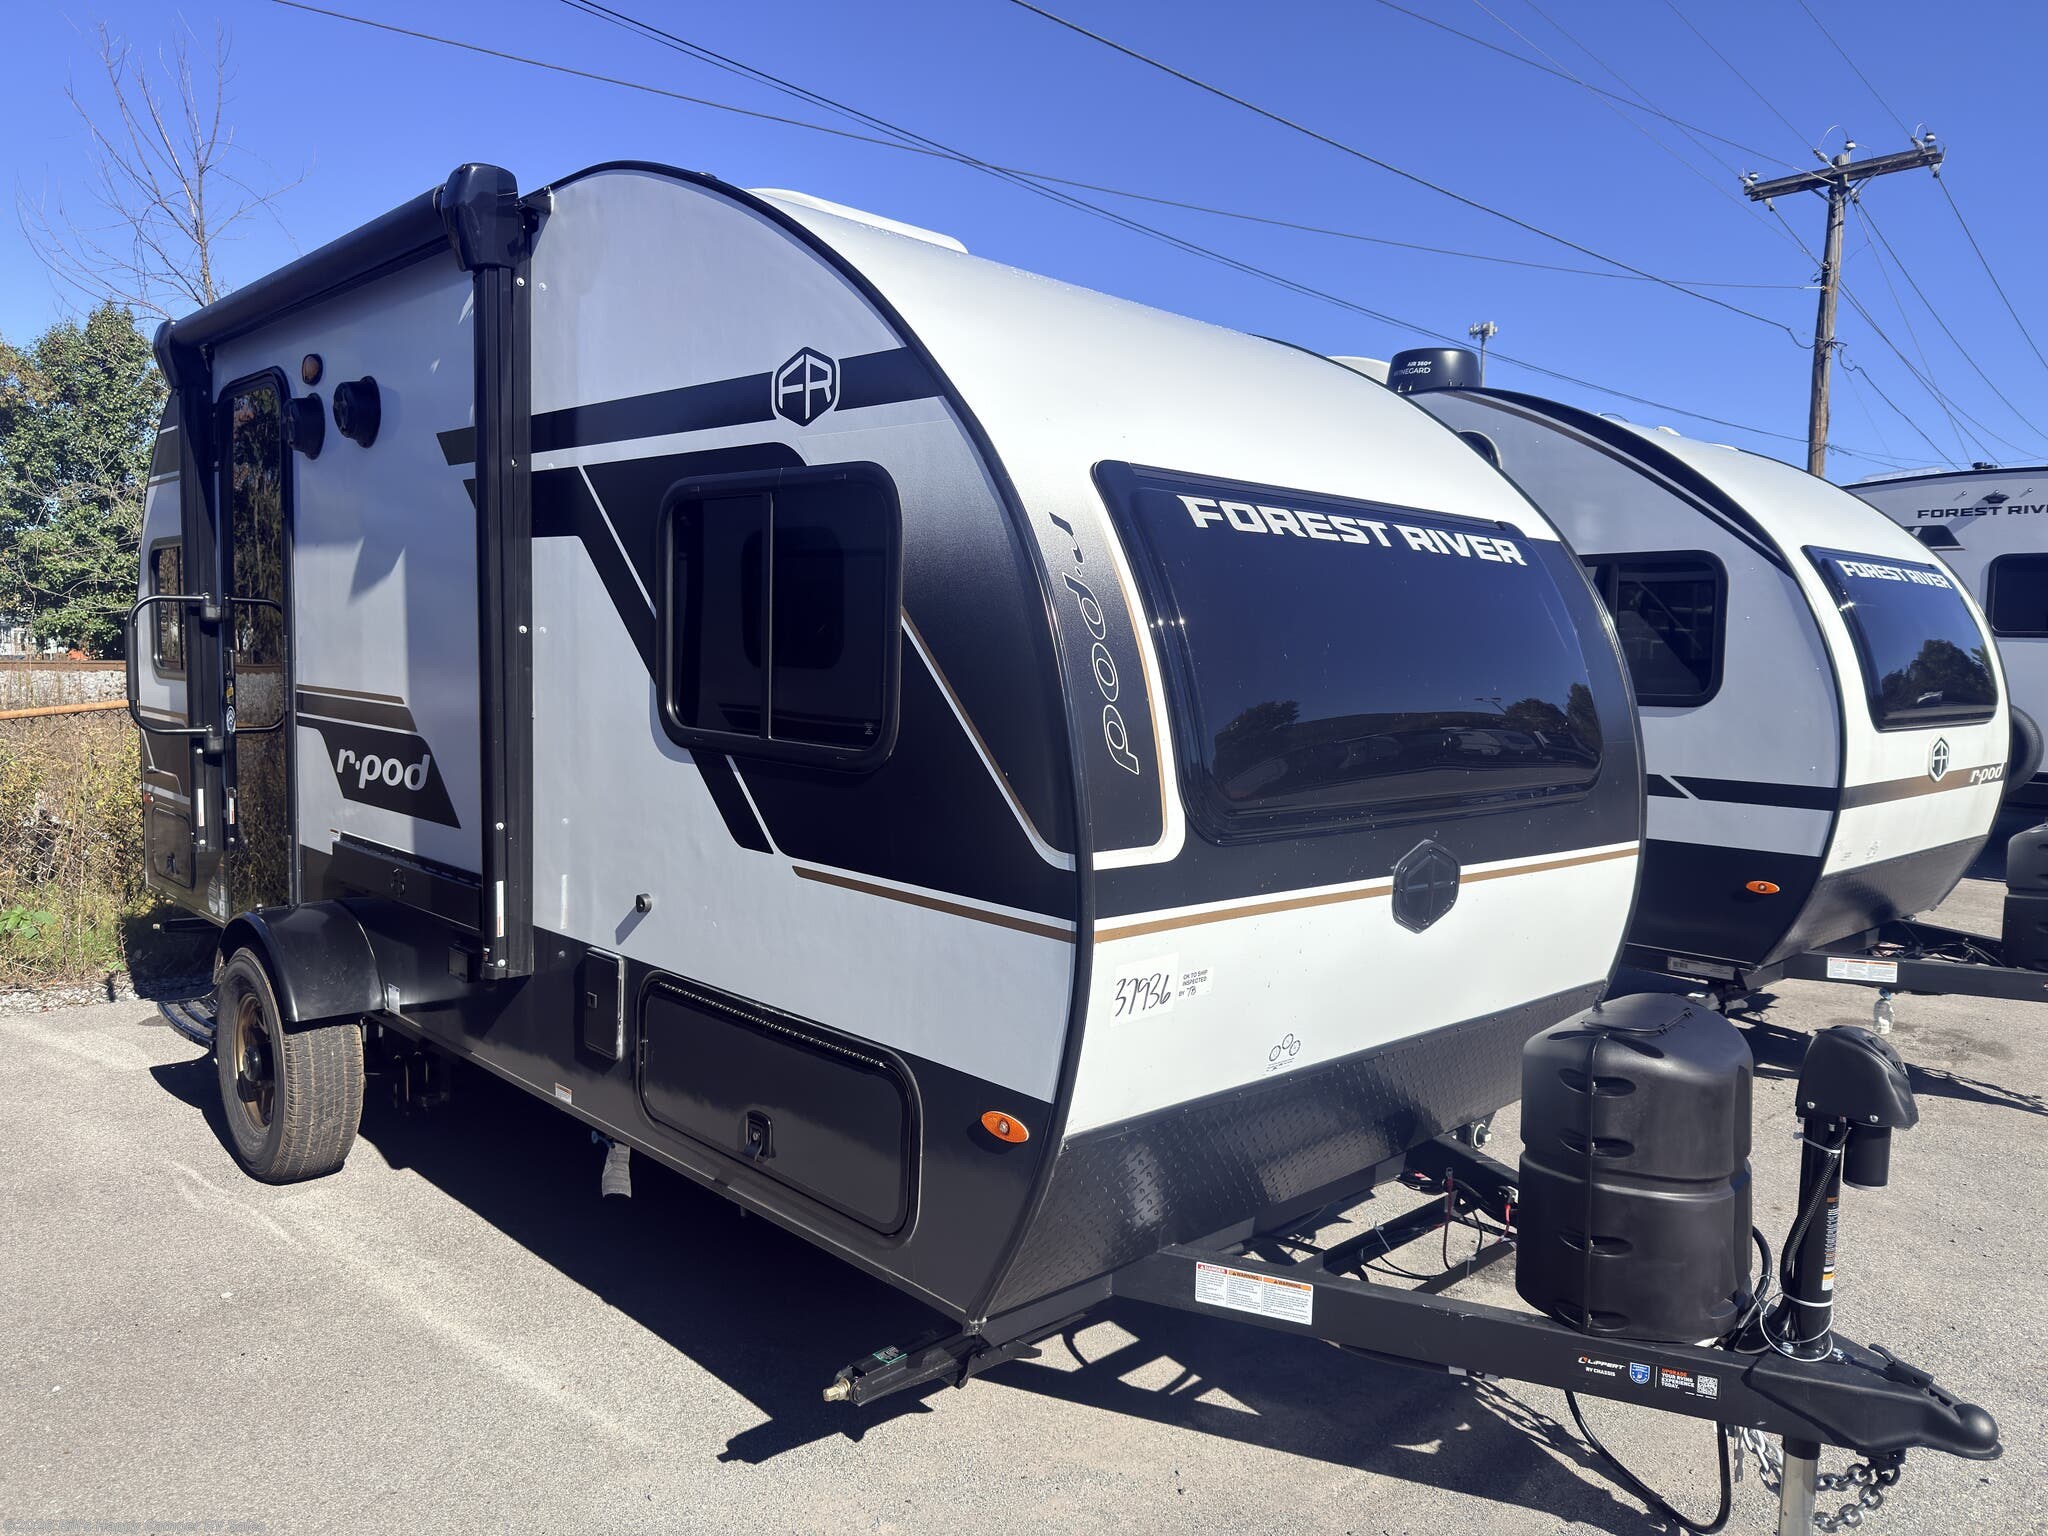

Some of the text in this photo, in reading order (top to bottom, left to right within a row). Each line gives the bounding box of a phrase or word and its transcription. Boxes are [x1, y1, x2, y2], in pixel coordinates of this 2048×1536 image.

[1917, 504, 2048, 519] FOREST RIV
[1176, 494, 1528, 566] FOREST RIVER
[1835, 560, 1953, 589] FOREST RIVER
[1114, 973, 1171, 1017] 37936
[1236, 1271, 1259, 1280] WARNING
[1277, 1280, 1301, 1289] WARNING
[1593, 1368, 1616, 1377] CHASSIS
[1661, 1368, 1688, 1377] UPGRADE
[1661, 1377, 1695, 1388] EXPERIENCE
